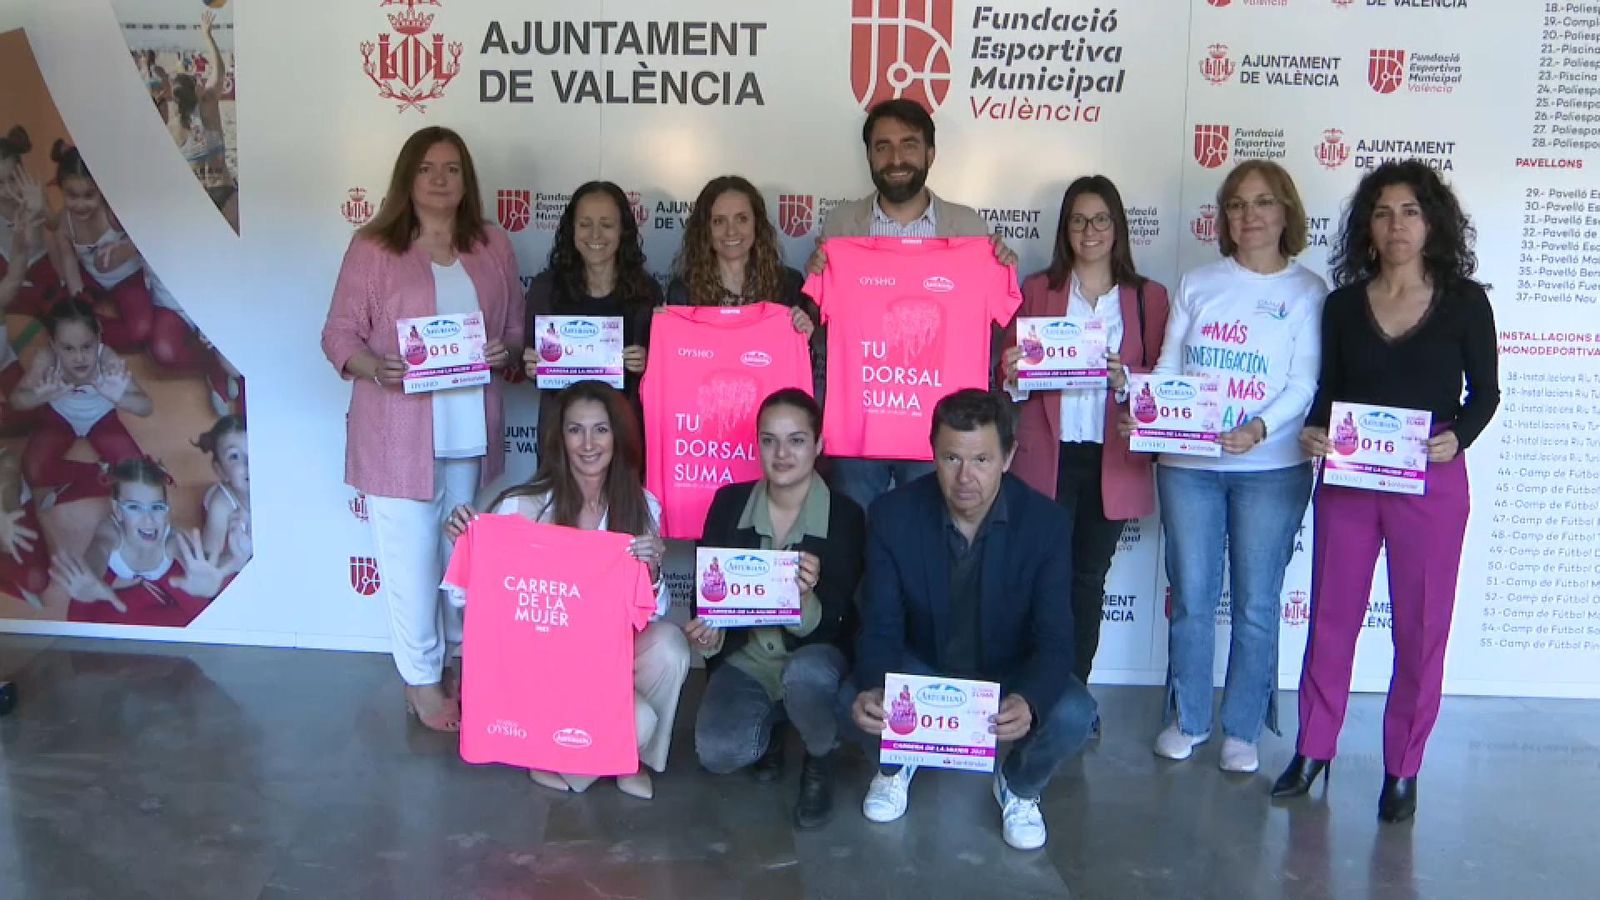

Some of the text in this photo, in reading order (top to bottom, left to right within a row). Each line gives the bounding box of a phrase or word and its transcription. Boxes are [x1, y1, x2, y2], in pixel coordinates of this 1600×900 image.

[972, 6, 1118, 33] Fundació
[480, 21, 767, 56] AJUNTAMENT
[971, 36, 1123, 66] Esportiva
[1409, 53, 1461, 63] Fundació
[1241, 54, 1341, 70] AJUNTAMENT
[1409, 63, 1461, 74] Esportiva
[480, 61, 765, 106] DE VALÈNCIA
[969, 66, 1126, 98] Municipal
[1240, 70, 1340, 87] DE VALÈNCIA
[1408, 73, 1462, 85] Municipal
[970, 96, 1101, 123] València
[1235, 129, 1285, 139] Fundació
[1234, 138, 1286, 149] Esportiva
[1356, 139, 1456, 154] AJUNTAMENT
[1233, 148, 1287, 160] Municipal
[1354, 156, 1374, 169] DE
[1515, 157, 1583, 169] PAVELLONS
[1200, 320, 1248, 344] #MÁS
[430, 342, 460, 356] 016
[860, 340, 886, 359] TU
[1046, 346, 1078, 358] 016
[861, 366, 942, 388] DORSAL
[1227, 375, 1266, 400] MÁS
[863, 389, 921, 410] SUMA
[1160, 406, 1192, 419] 016
[675, 413, 701, 431] TU
[675, 439, 756, 461] DORSAL
[1361, 438, 1395, 453] 016
[674, 463, 734, 483] SUMA
[504, 575, 580, 599] CARRERA
[730, 583, 766, 596] 016
[519, 592, 567, 611] DE LA
[515, 607, 569, 627] MUJER
[921, 714, 959, 729] 016
